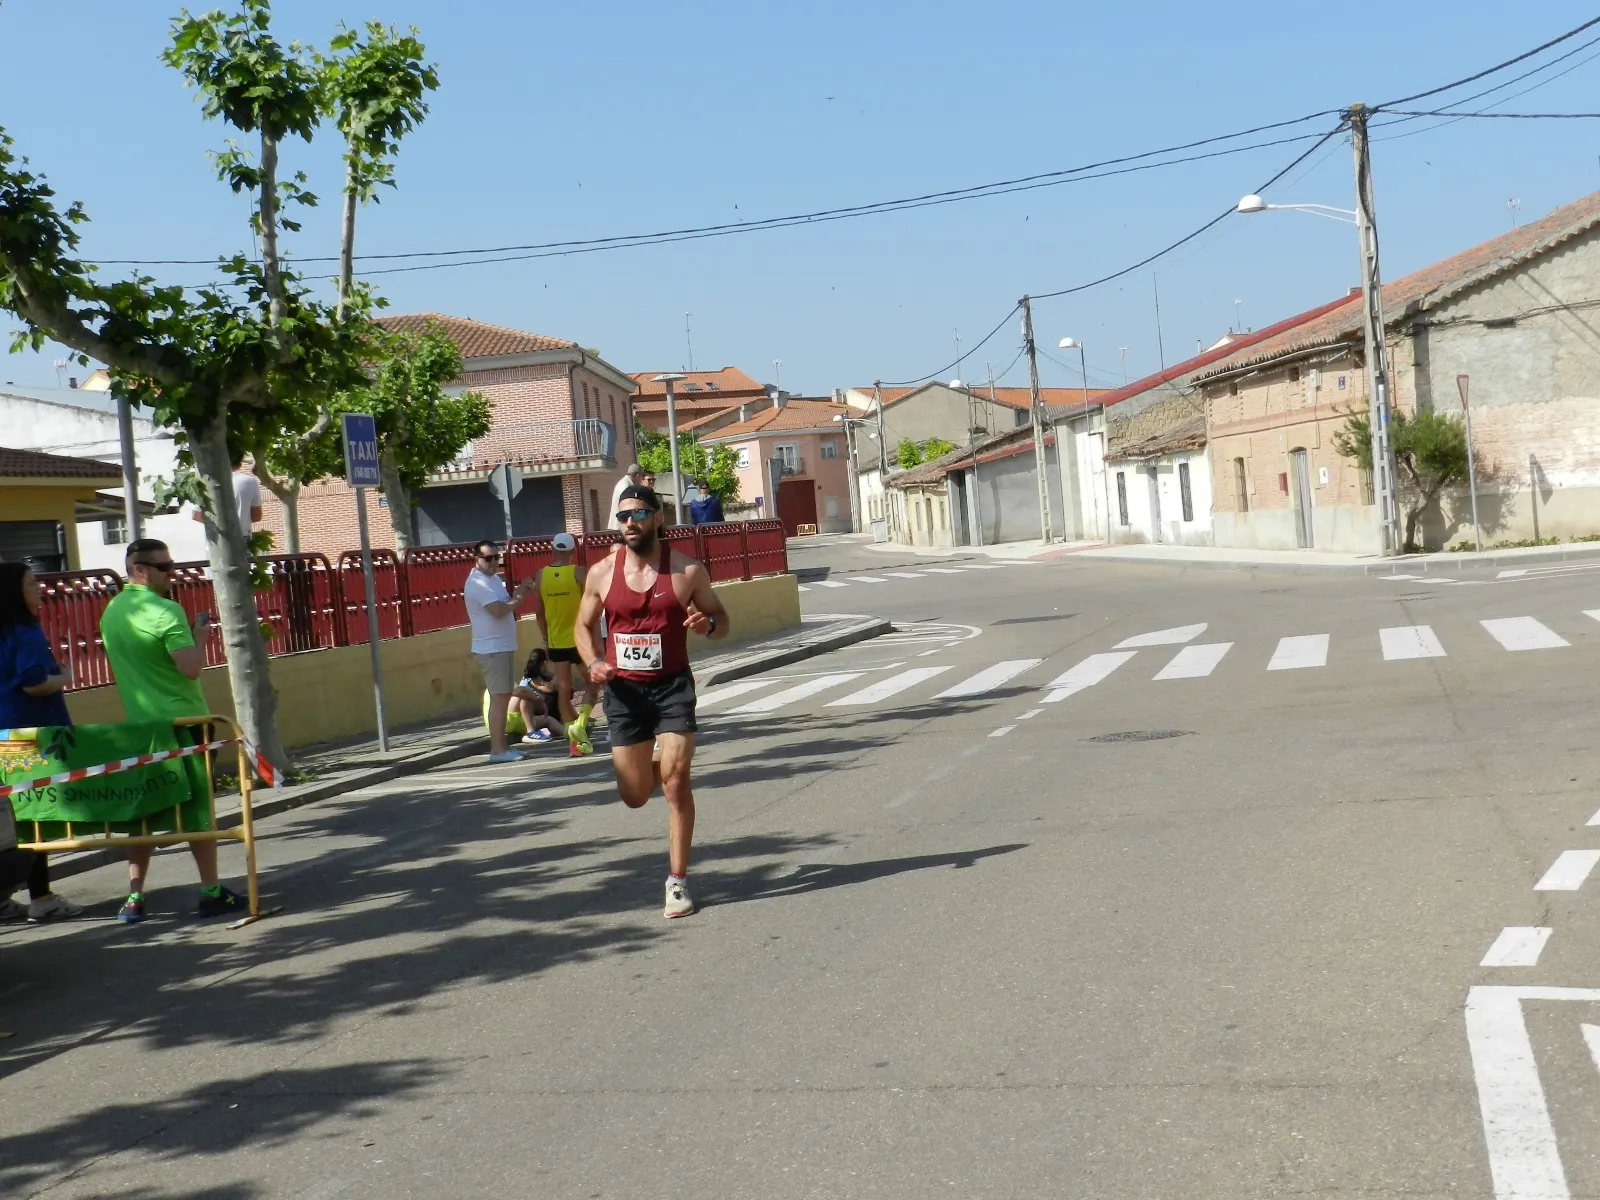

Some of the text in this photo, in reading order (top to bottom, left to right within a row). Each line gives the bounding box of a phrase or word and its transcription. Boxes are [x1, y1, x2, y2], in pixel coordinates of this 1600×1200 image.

[349, 441, 376, 460] TAXI
[623, 647, 652, 661] 454
[18, 786, 57, 803] SAN
